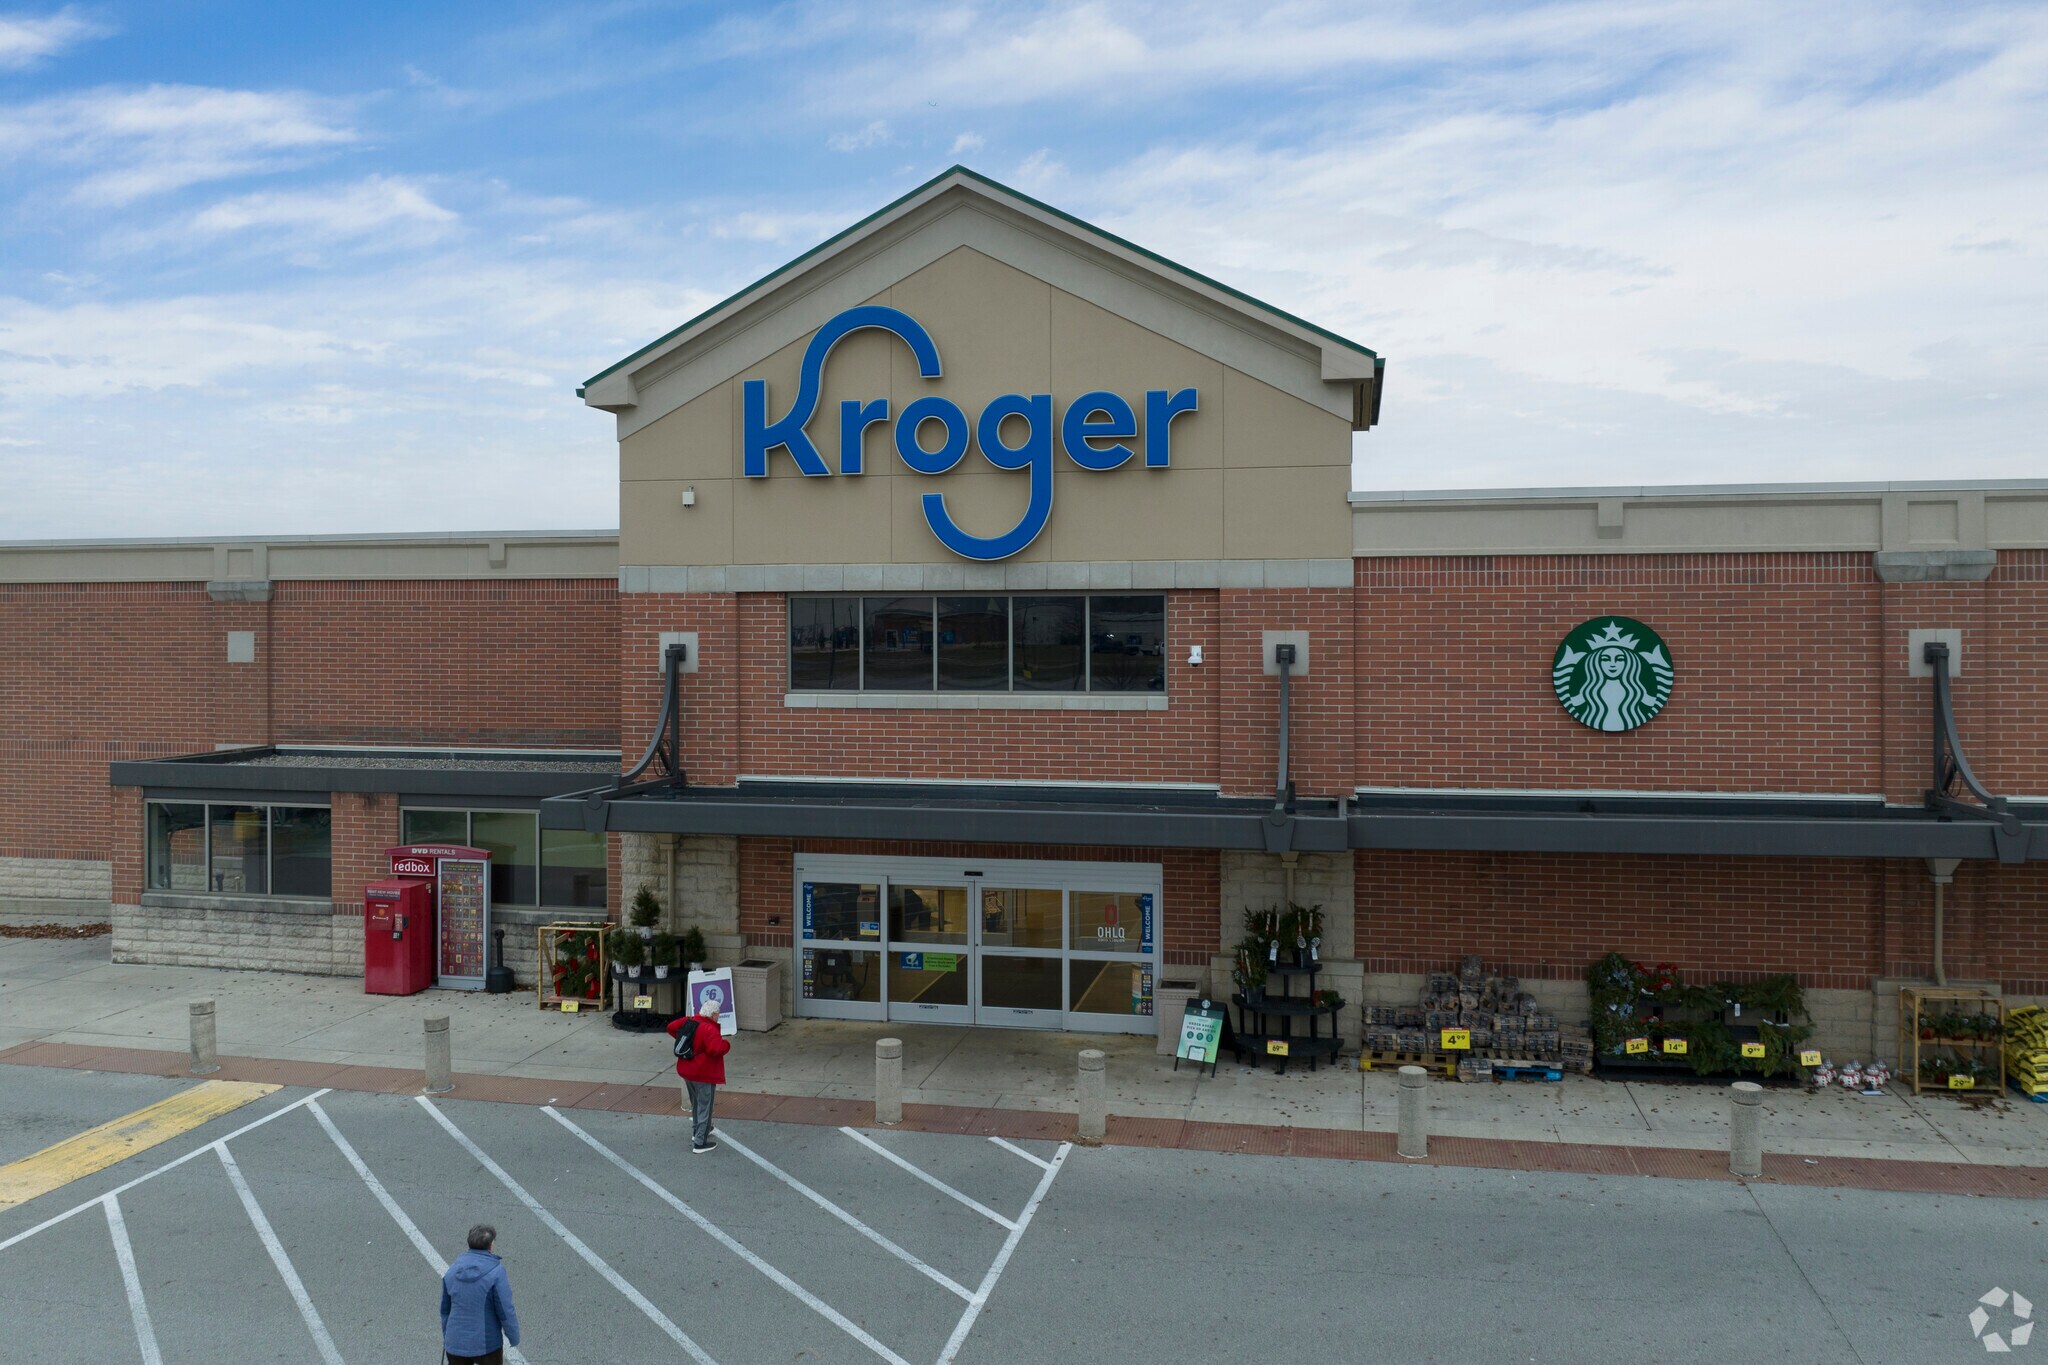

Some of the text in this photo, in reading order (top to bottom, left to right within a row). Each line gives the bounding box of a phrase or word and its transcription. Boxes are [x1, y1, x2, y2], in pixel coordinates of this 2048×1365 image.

[743, 305, 1199, 561] Kroger
[394, 862, 430, 873] redbox
[1097, 926, 1125, 939] OHLQ
[706, 988, 717, 1000] $6
